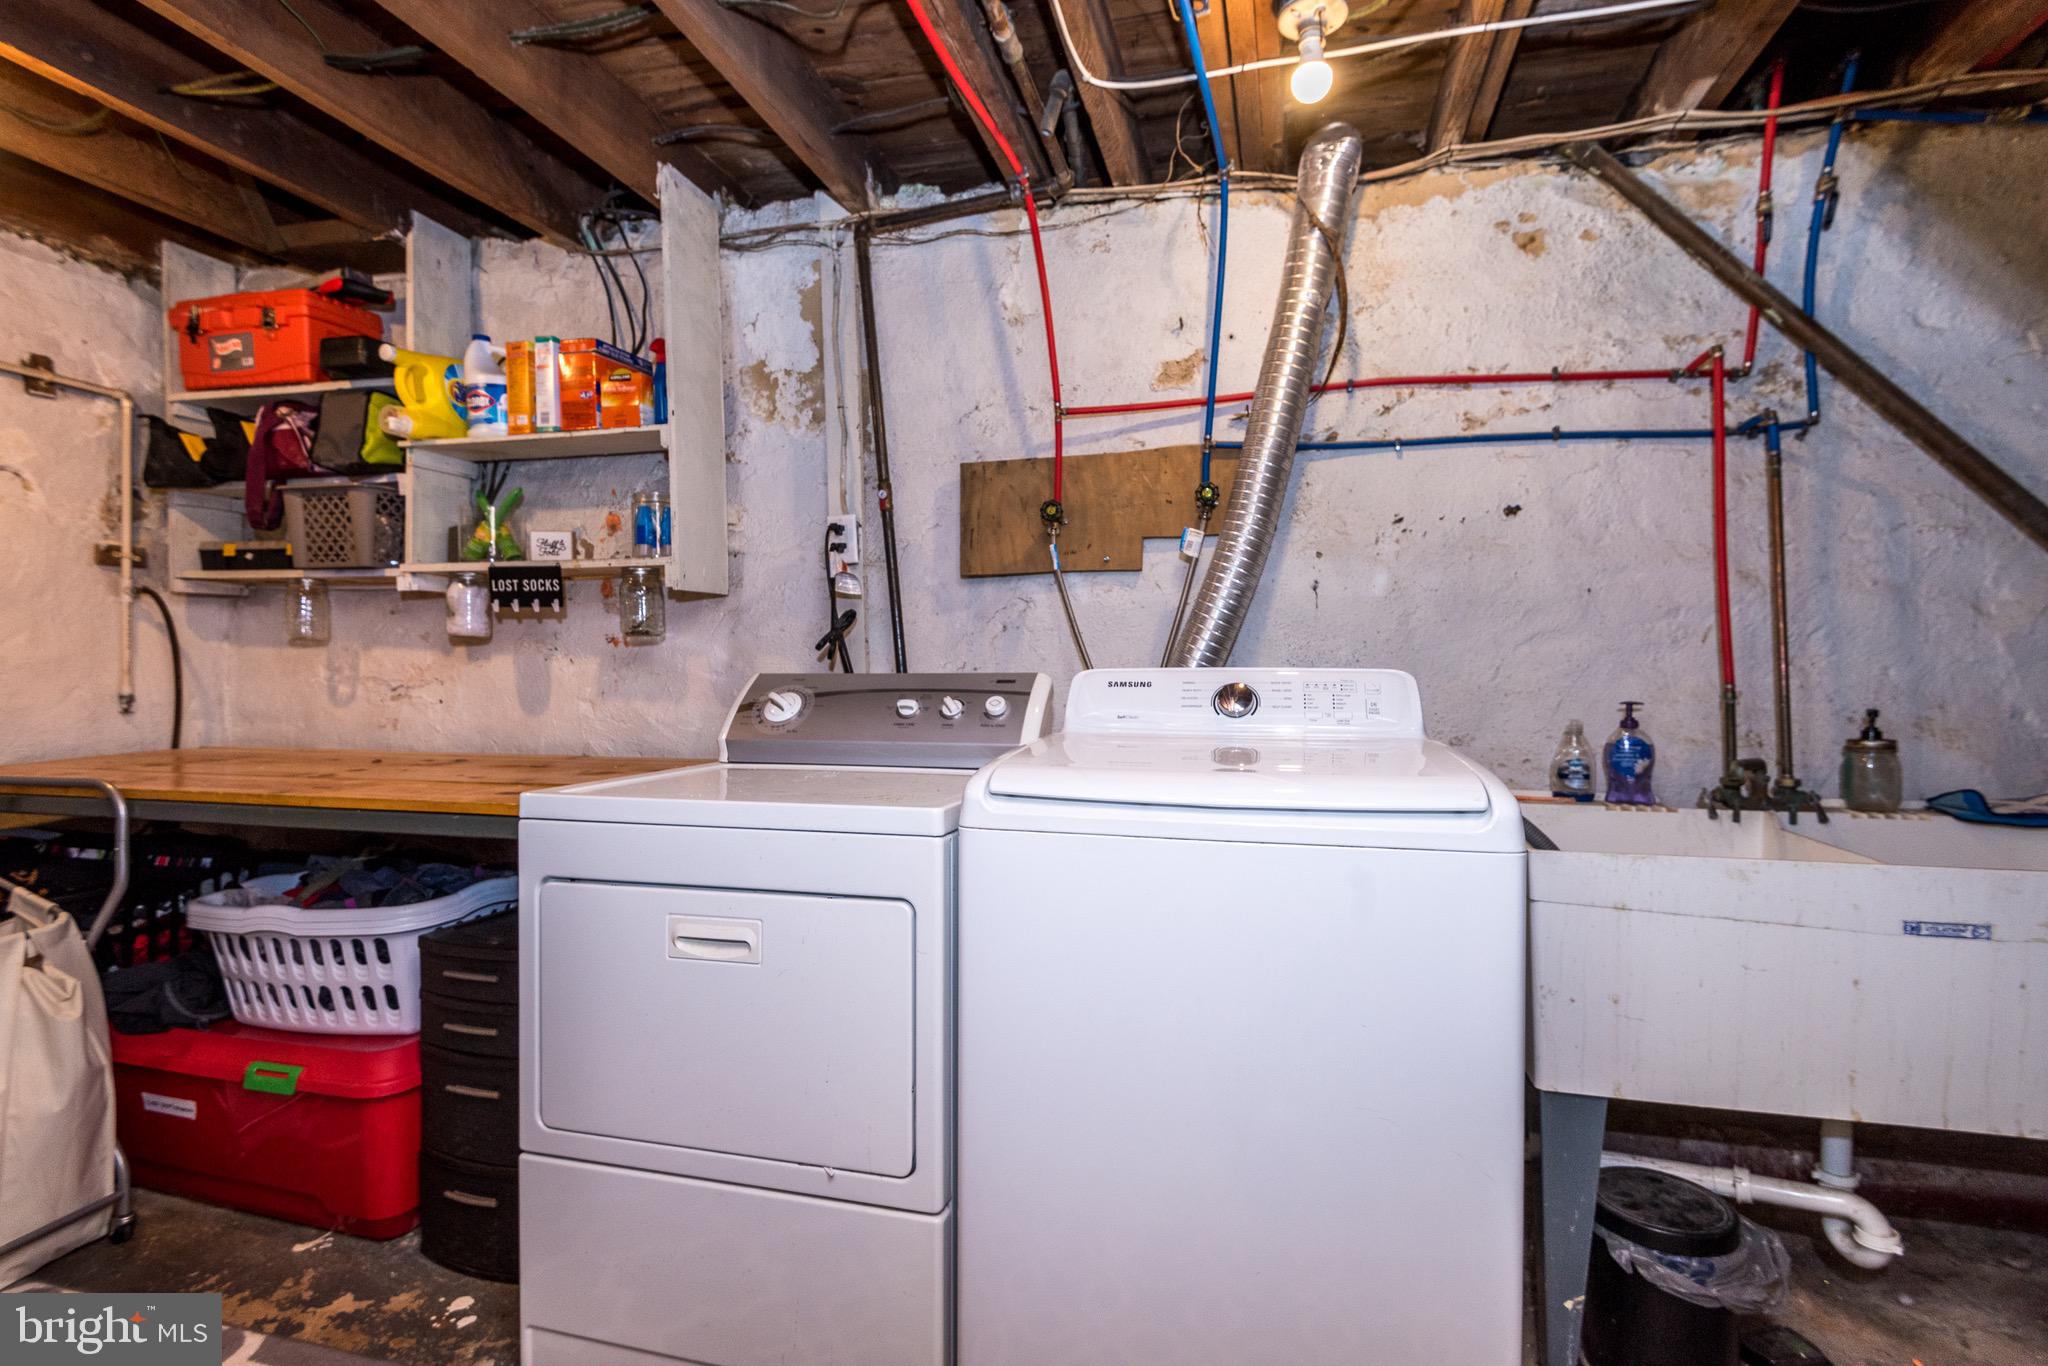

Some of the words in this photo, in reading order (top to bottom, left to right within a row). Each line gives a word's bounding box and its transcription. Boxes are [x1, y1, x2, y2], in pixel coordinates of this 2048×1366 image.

[491, 578, 519, 592] LOST
[522, 578, 560, 592] SOCKS
[1107, 680, 1152, 688] SAMSUNG
